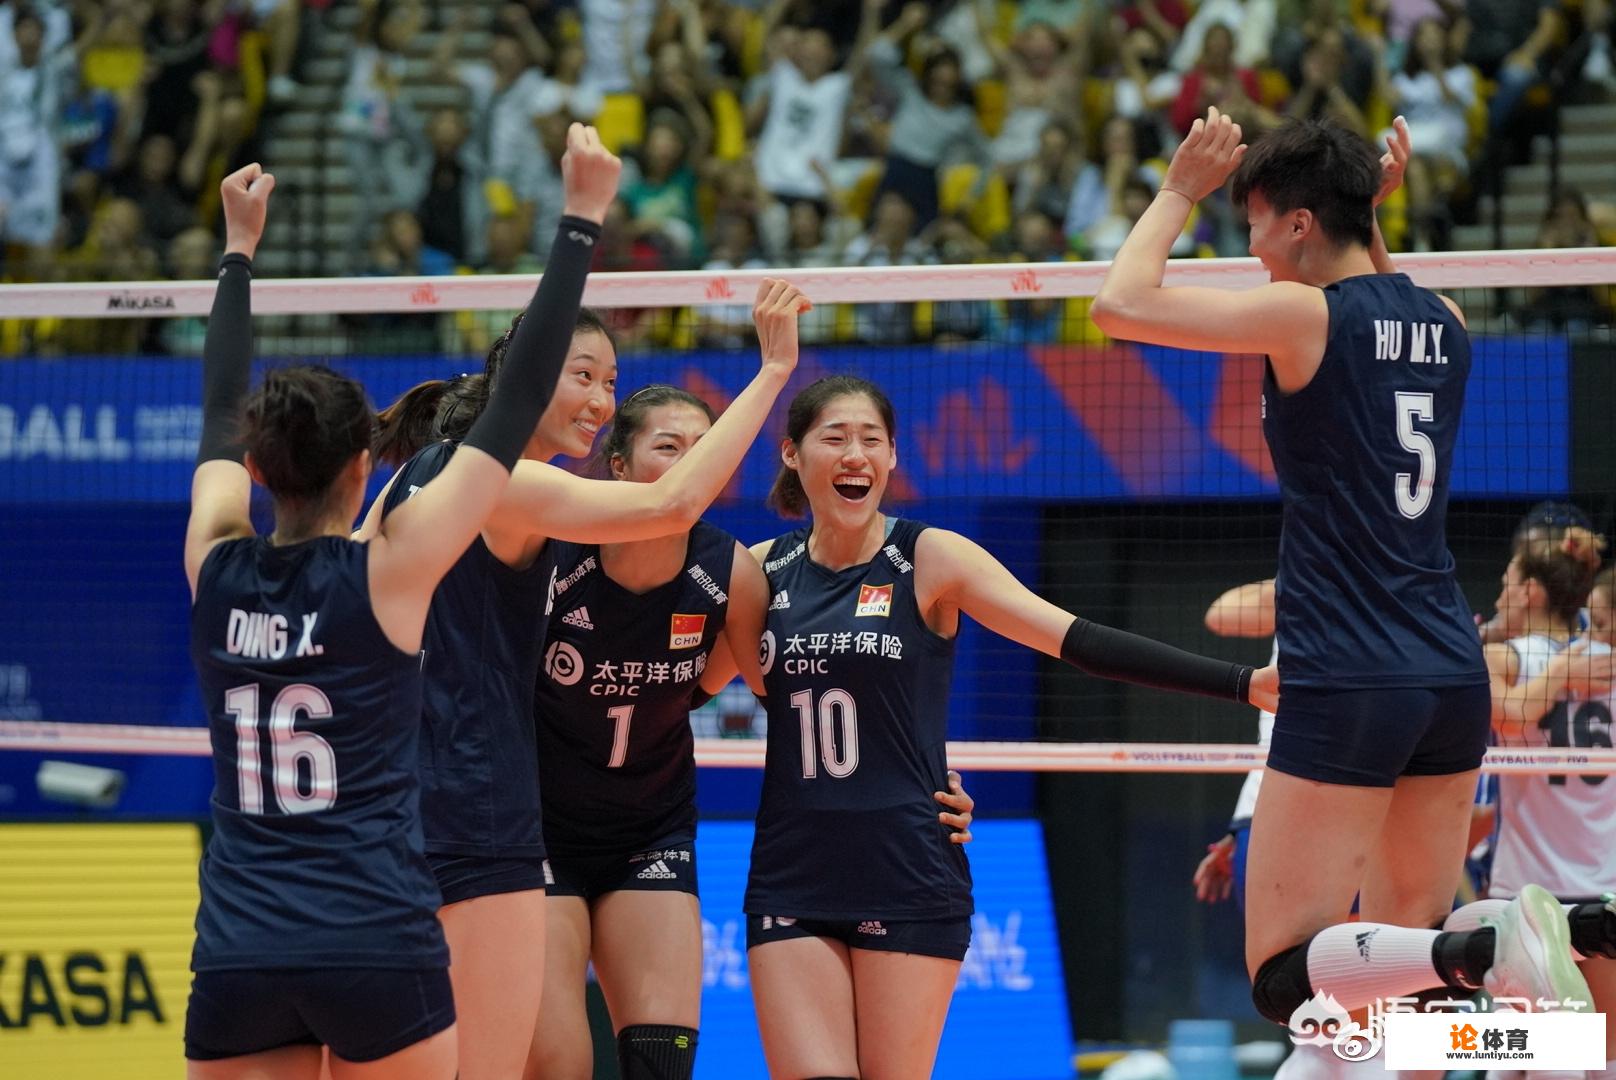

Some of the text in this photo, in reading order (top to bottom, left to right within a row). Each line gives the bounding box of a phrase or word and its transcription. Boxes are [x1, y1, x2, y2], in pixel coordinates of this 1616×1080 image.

[1374, 319, 1449, 364] HU M.Y.
[1394, 390, 1437, 520] 5
[555, 555, 597, 596] 腾讯体育
[687, 563, 729, 605] 腾讯体育
[561, 615, 594, 631] adidas
[860, 604, 886, 613] CHN
[226, 608, 325, 660] DING X.
[674, 635, 700, 646] CHN
[783, 631, 903, 660] 太平洋保险
[784, 658, 829, 674] CPIC
[589, 683, 640, 696] CPIC
[224, 682, 338, 816] 16
[607, 704, 635, 768] 1
[790, 688, 859, 779] 10
[1537, 696, 1614, 786] 16
[637, 871, 677, 880] adidas
[857, 925, 887, 936] adidas
